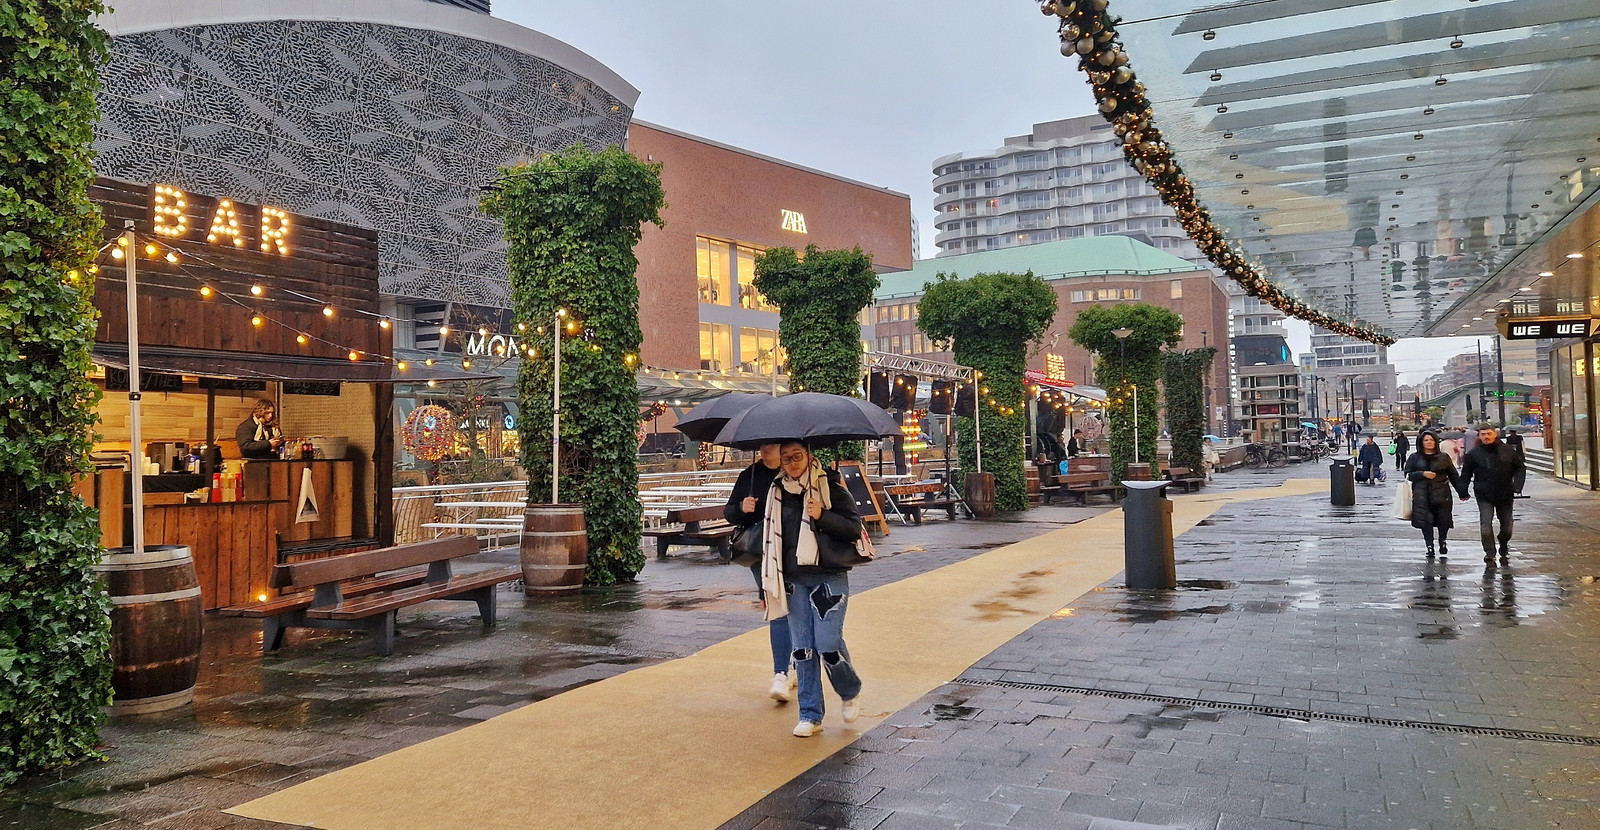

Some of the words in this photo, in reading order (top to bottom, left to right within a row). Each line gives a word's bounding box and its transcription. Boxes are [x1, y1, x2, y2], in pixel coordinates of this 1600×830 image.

[153, 184, 291, 255] BAR
[781, 209, 808, 234] ZARA
[1513, 325, 1541, 336] WE
[1557, 323, 1585, 334] WE
[467, 333, 519, 358] MON
